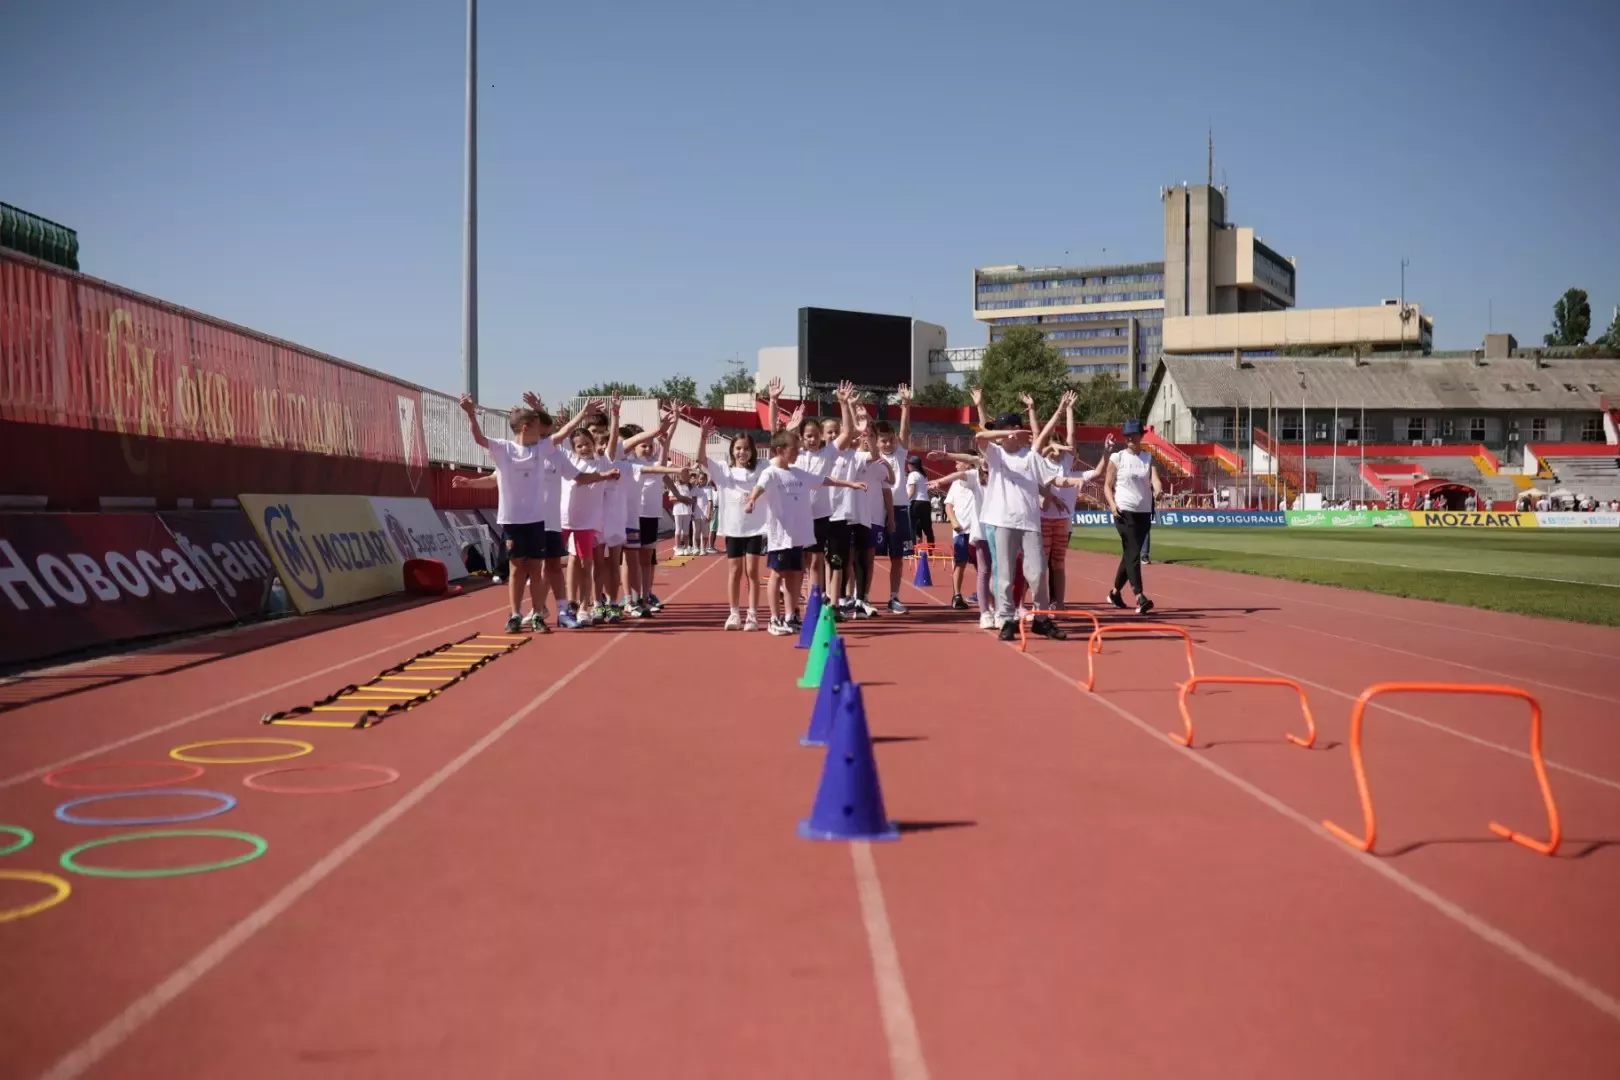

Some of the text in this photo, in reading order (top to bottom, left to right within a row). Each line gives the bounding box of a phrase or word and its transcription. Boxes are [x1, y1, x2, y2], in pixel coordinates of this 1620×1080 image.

[1076, 513, 1108, 524] NOVE
[1182, 515, 1214, 523] DDOR
[1216, 515, 1285, 524] OSIGURANJE
[1425, 513, 1522, 527] MOZZART
[312, 529, 398, 573] MOZZART
